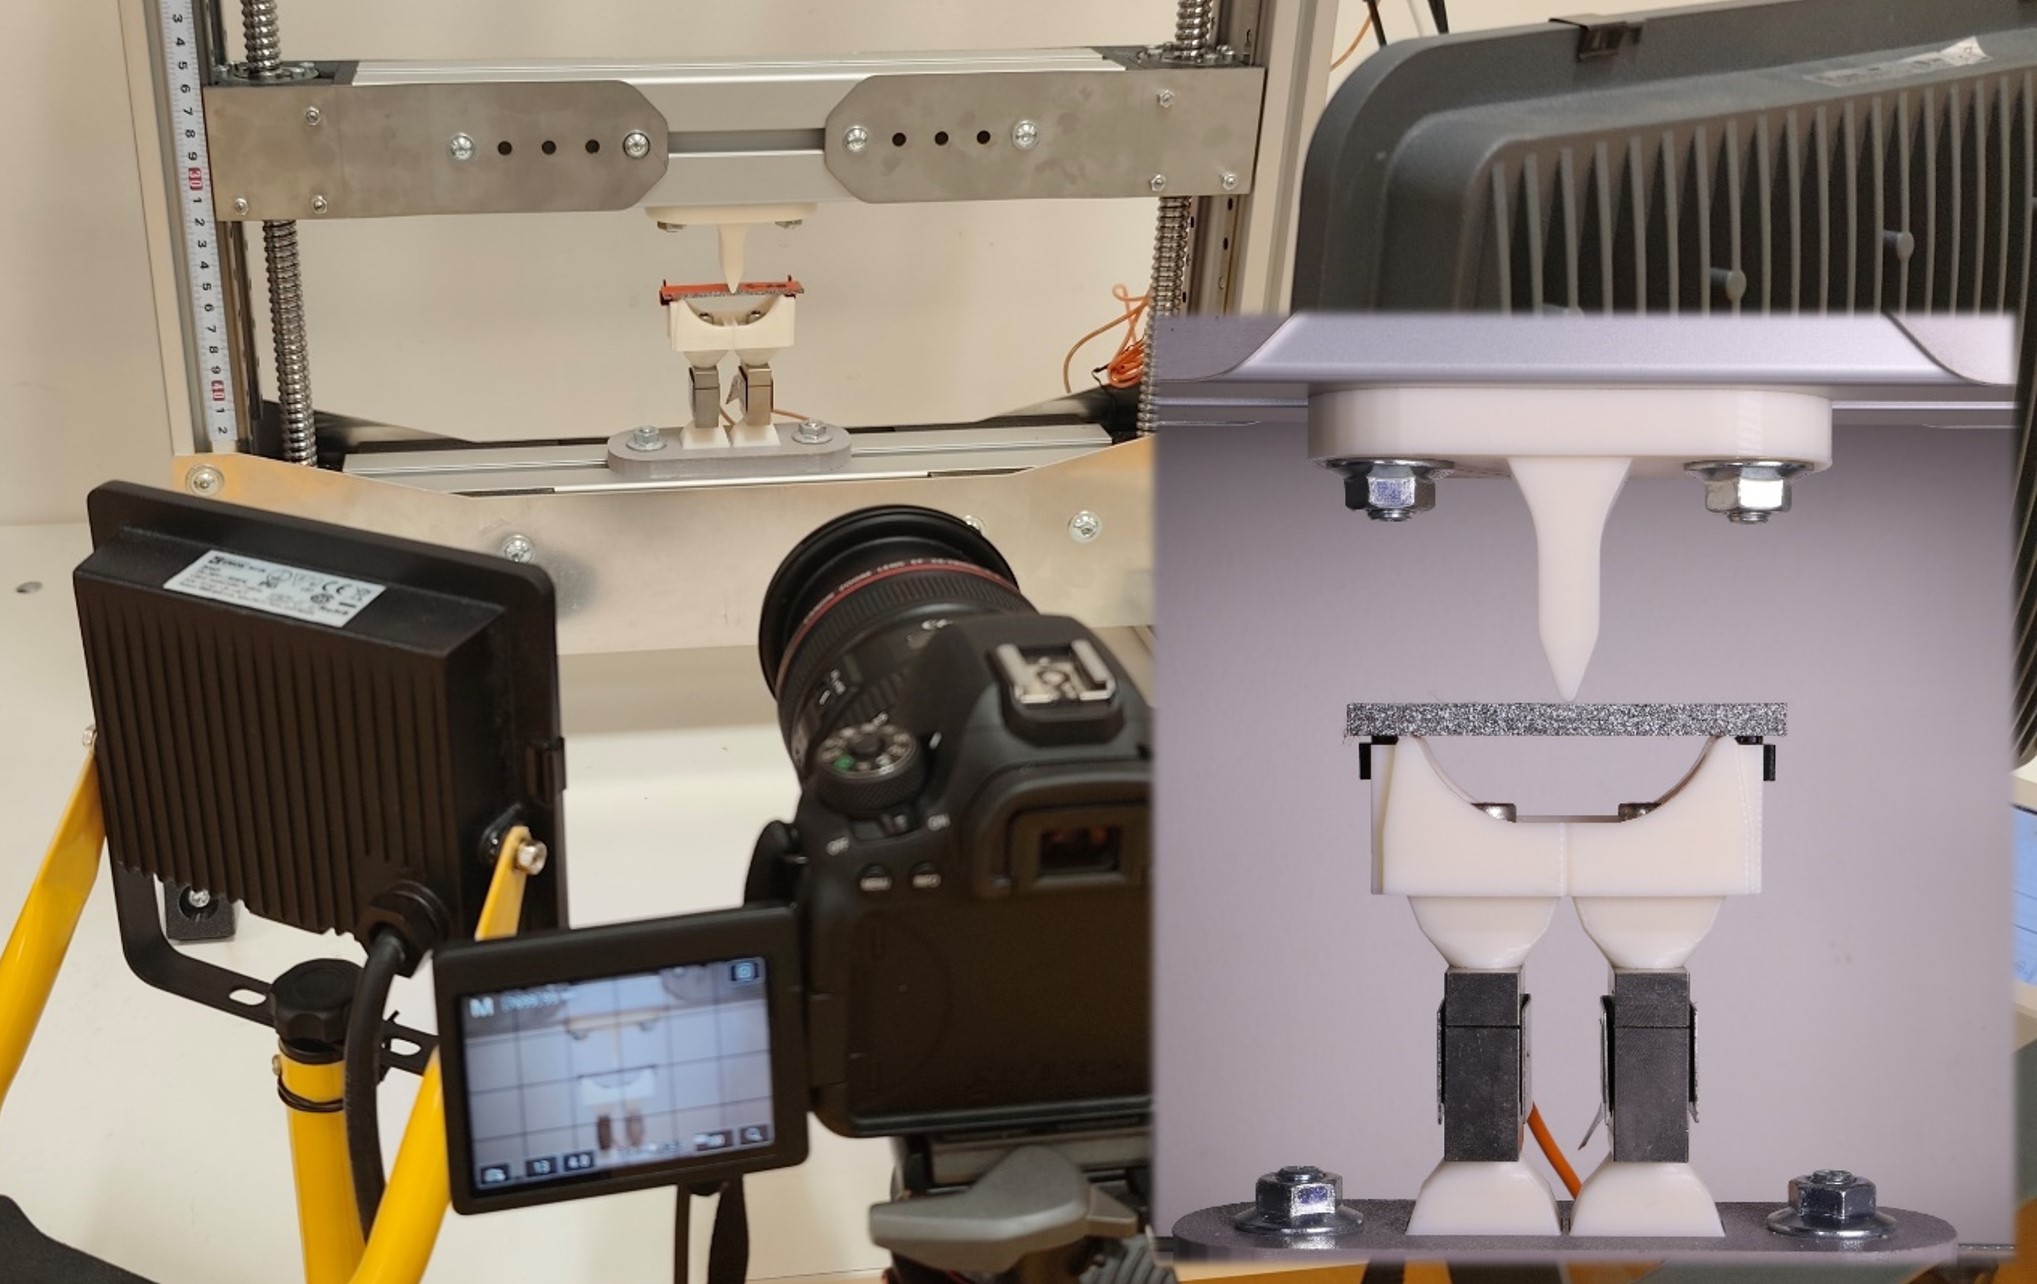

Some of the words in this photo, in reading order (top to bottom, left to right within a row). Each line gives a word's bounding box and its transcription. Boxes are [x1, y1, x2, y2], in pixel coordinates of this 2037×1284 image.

[171, 13, 183, 23] 3
[175, 37, 186, 46] 4
[178, 61, 188, 70] 5
[180, 84, 191, 93] 6
[183, 107, 193, 116] 7
[185, 129, 195, 138] 8
[188, 152, 198, 161] 9
[195, 218, 205, 227] 2
[198, 240, 207, 248] 3
[200, 261, 210, 270] 4
[202, 282, 212, 291] 5
[204, 303, 215, 312] 6
[206, 325, 217, 333] 7
[208, 345, 219, 354] 8
[211, 365, 221, 375] 9
[217, 426, 228, 434] 2
